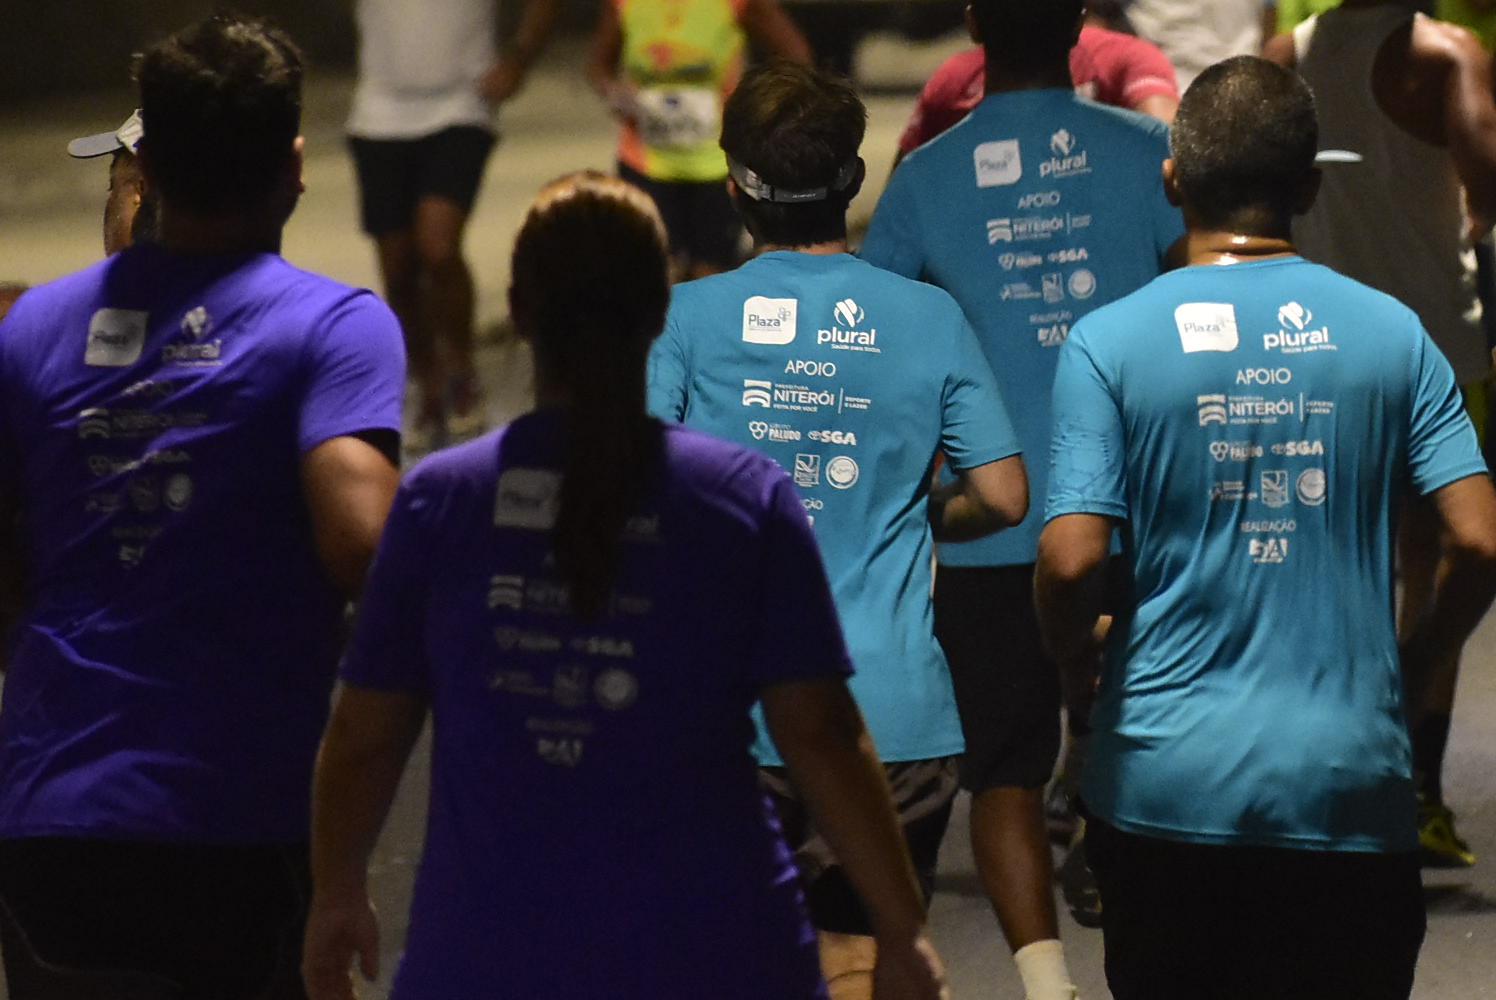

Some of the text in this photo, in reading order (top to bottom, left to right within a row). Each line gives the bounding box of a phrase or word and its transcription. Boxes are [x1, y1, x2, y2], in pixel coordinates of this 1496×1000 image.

[1039, 150, 1087, 178] plural
[1017, 191, 1060, 209] APOIO
[748, 314, 781, 328] Plaza
[1183, 321, 1222, 335] Plaza
[817, 326, 876, 345] plural
[1263, 326, 1329, 350] plural
[785, 360, 836, 377] APOIO
[1236, 367, 1291, 385] APOIO
[774, 390, 835, 406] NITERÓI
[1229, 398, 1293, 416] NITERÓI
[769, 428, 801, 441] PALUDO
[820, 430, 857, 446] SGA
[1285, 440, 1324, 456] SGA
[1240, 519, 1297, 533] REALIZAÇÃO
